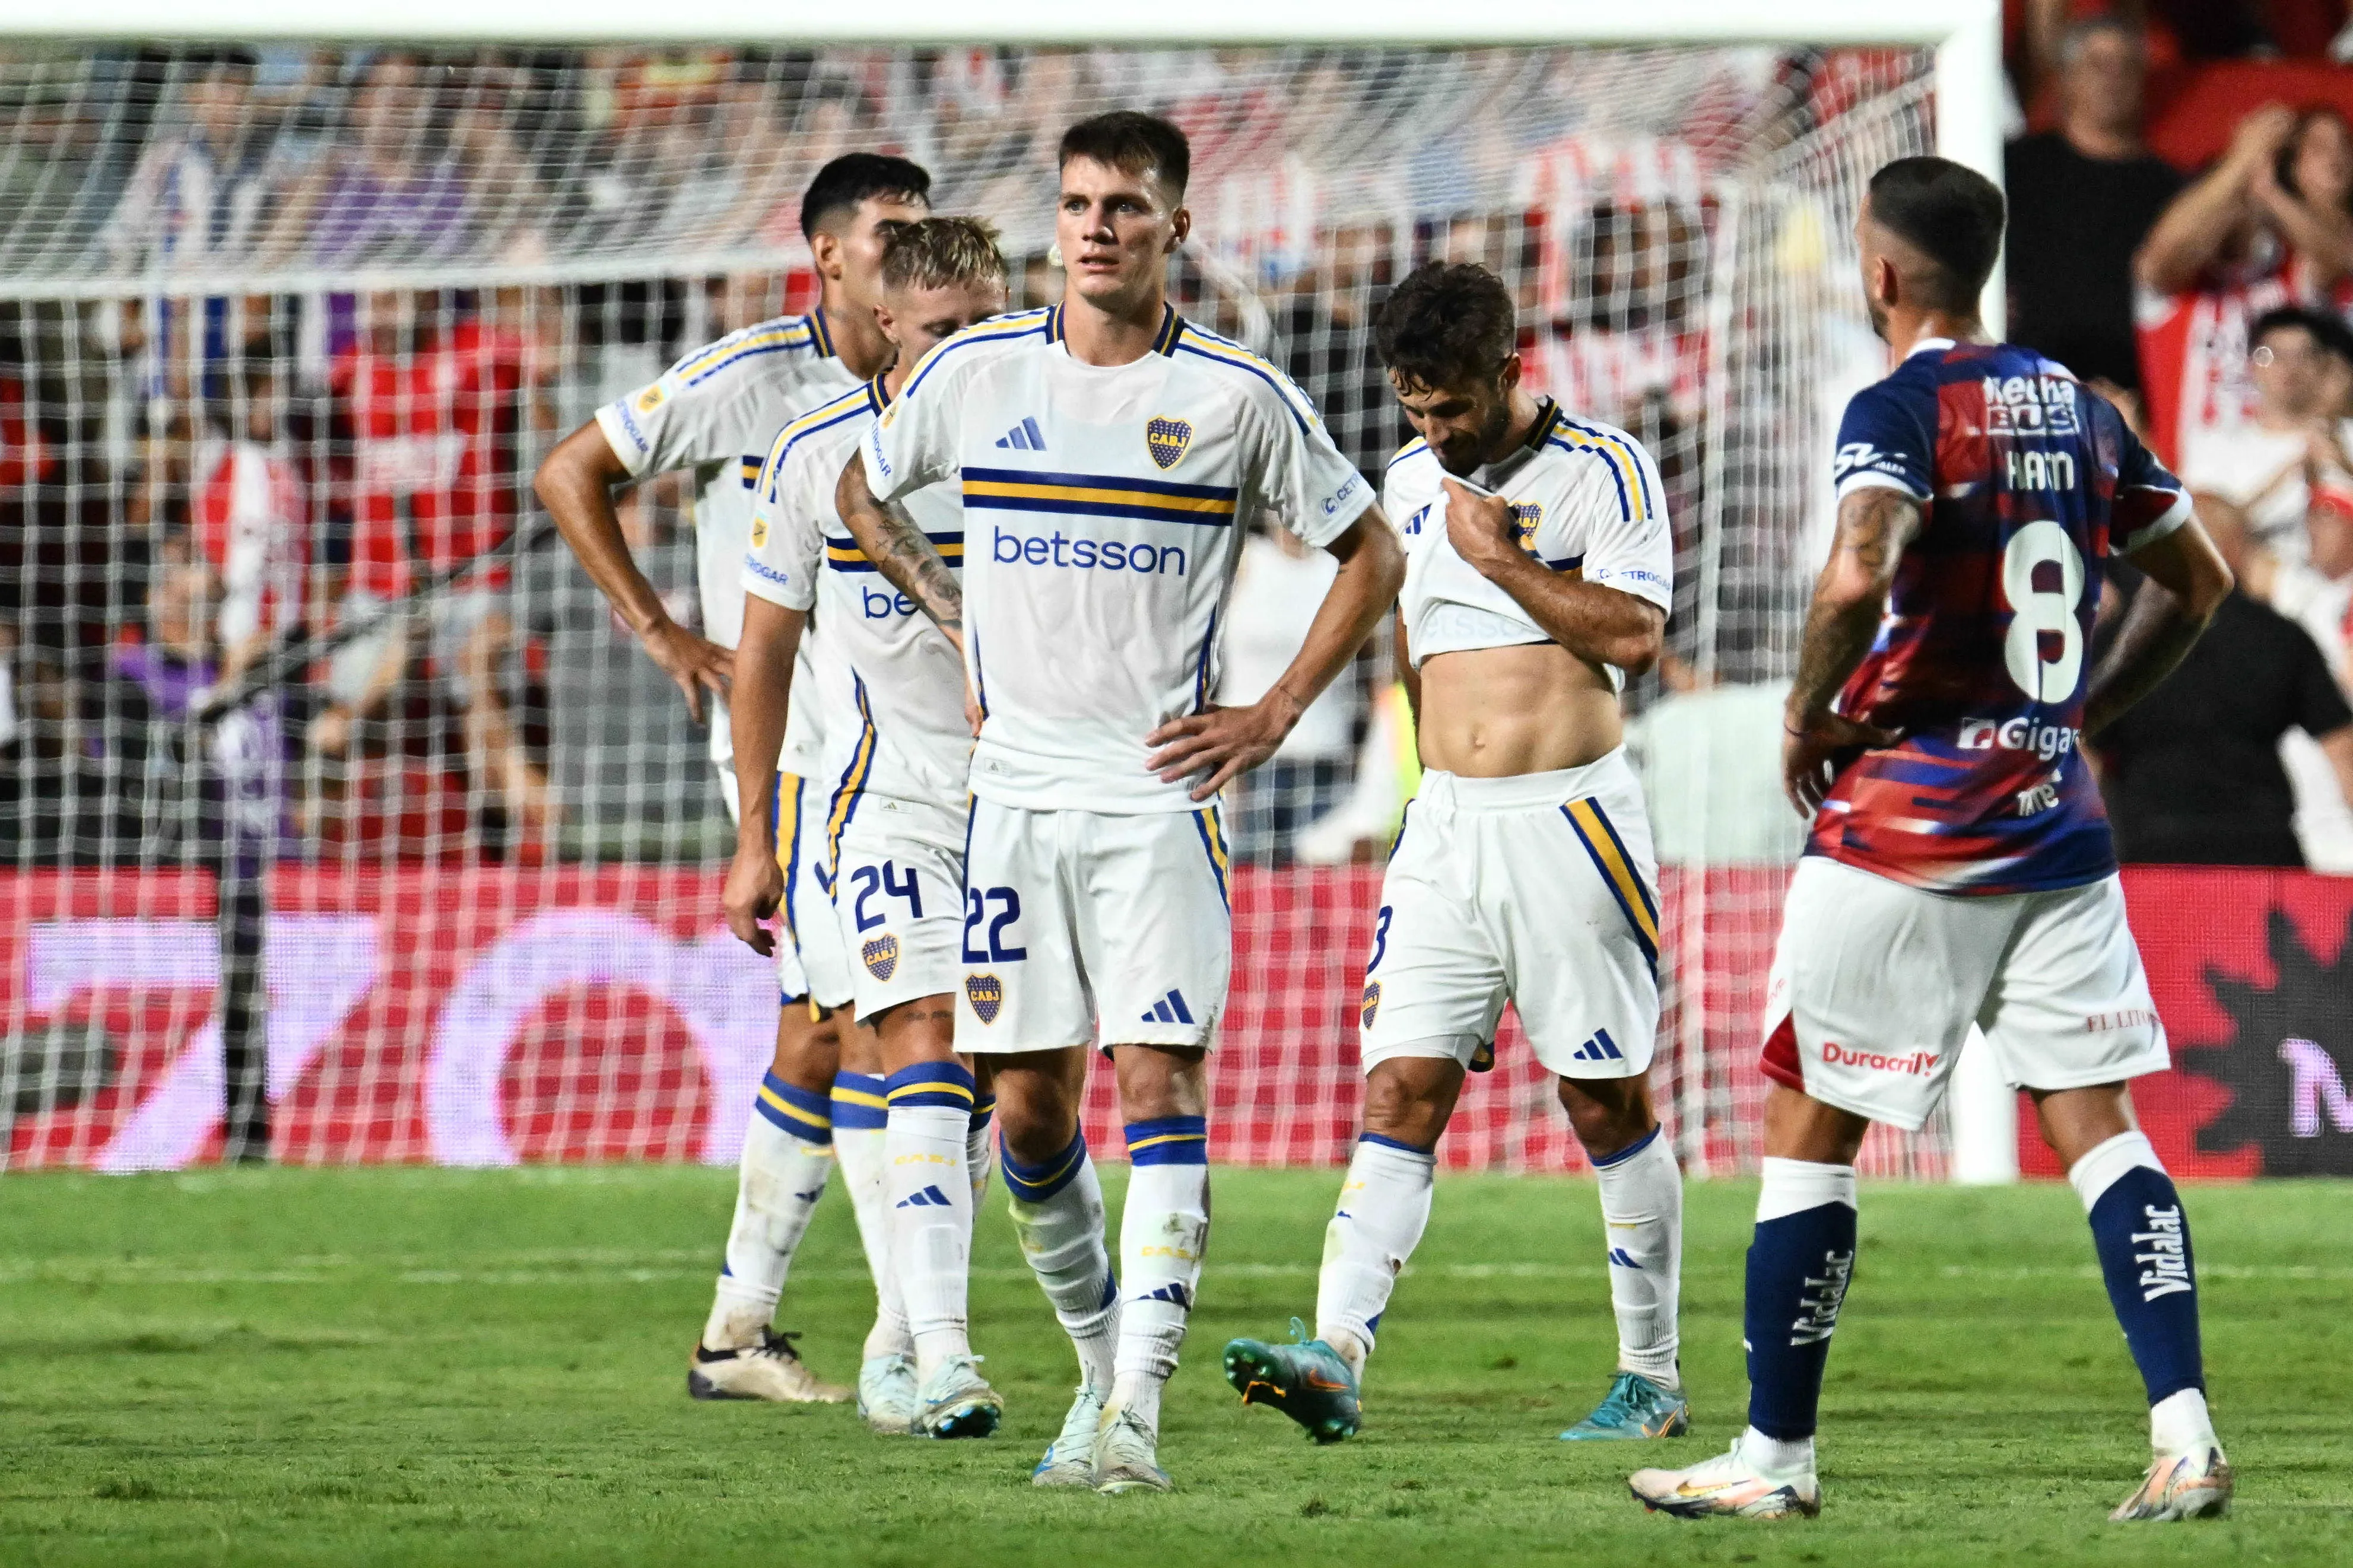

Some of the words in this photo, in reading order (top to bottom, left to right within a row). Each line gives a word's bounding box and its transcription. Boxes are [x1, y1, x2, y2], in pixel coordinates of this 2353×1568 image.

[1150, 433, 1187, 448] CABJ
[993, 525, 1186, 576] betsson
[2003, 520, 2085, 704] 8
[851, 860, 923, 933] 24
[962, 886, 1028, 965] 22
[970, 990, 1000, 1001] CABJ
[2132, 1203, 2192, 1303] Vidalac
